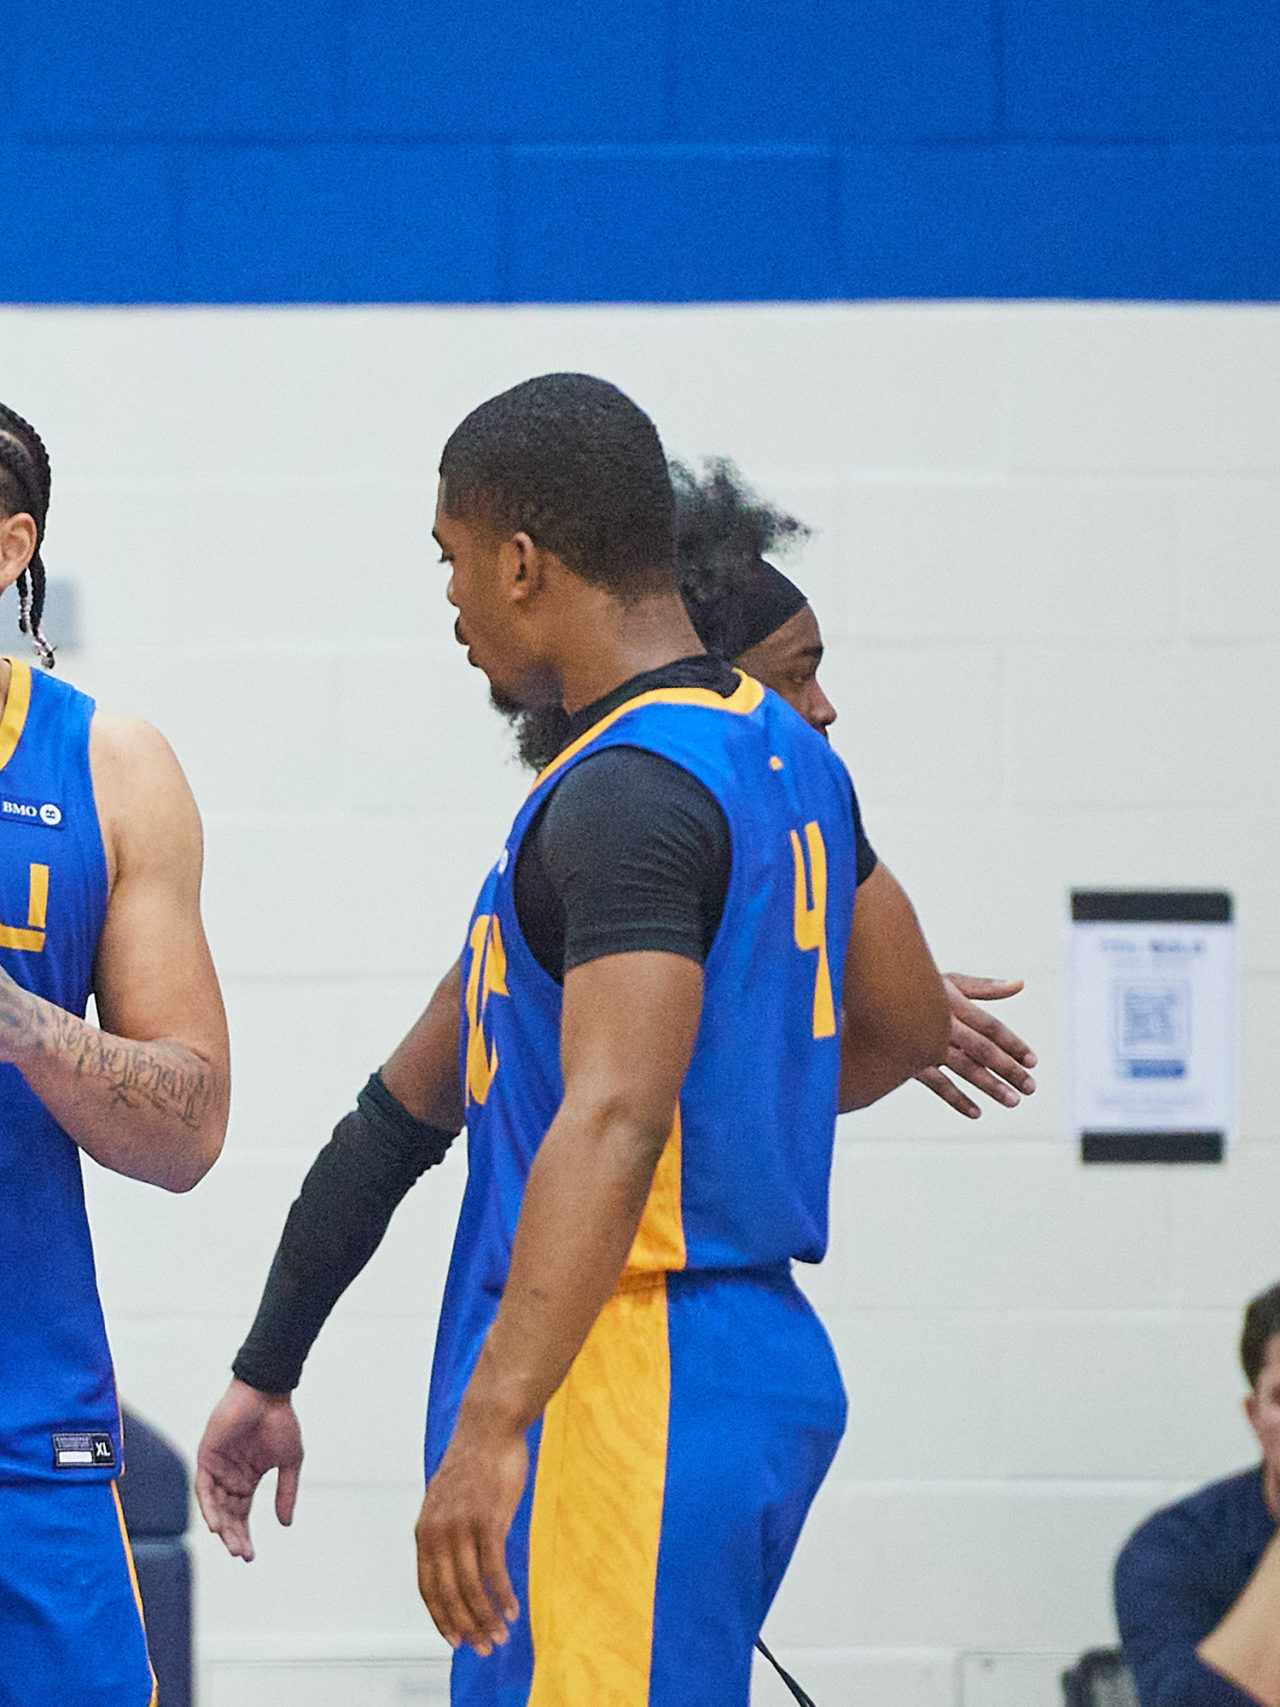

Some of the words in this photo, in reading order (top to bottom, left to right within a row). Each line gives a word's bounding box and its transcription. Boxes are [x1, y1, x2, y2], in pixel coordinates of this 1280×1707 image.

[3, 800, 38, 817] BMO
[790, 820, 836, 1039] 4
[95, 1441, 111, 1457] XL
